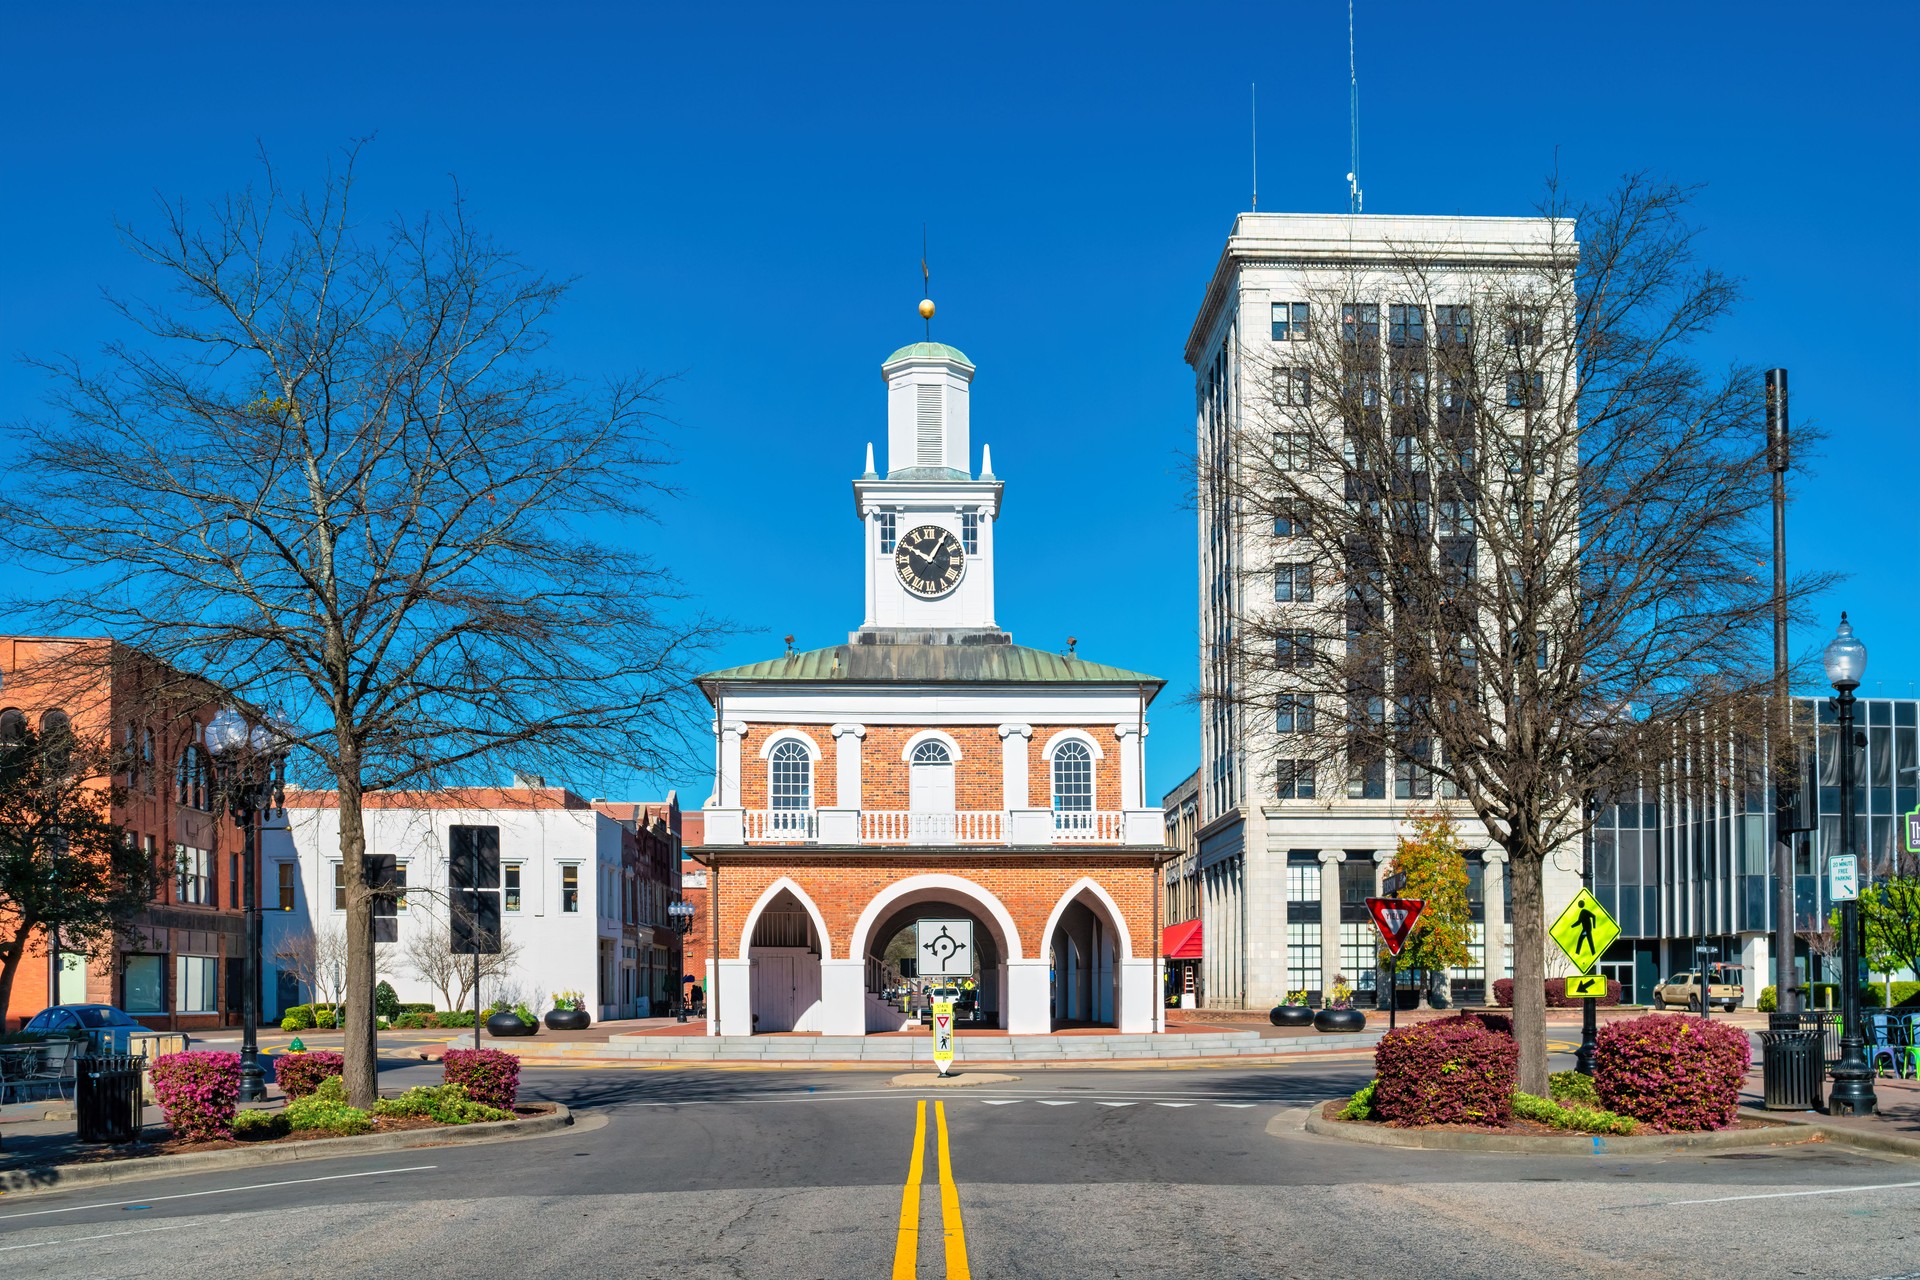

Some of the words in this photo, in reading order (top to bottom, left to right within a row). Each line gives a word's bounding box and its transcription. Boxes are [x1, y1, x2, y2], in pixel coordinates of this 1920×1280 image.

[911, 532, 922, 544] XI
[924, 529, 935, 539] XII
[947, 543, 957, 552] II
[949, 556, 960, 565] III
[926, 581, 936, 591] VI
[940, 578, 948, 588] V
